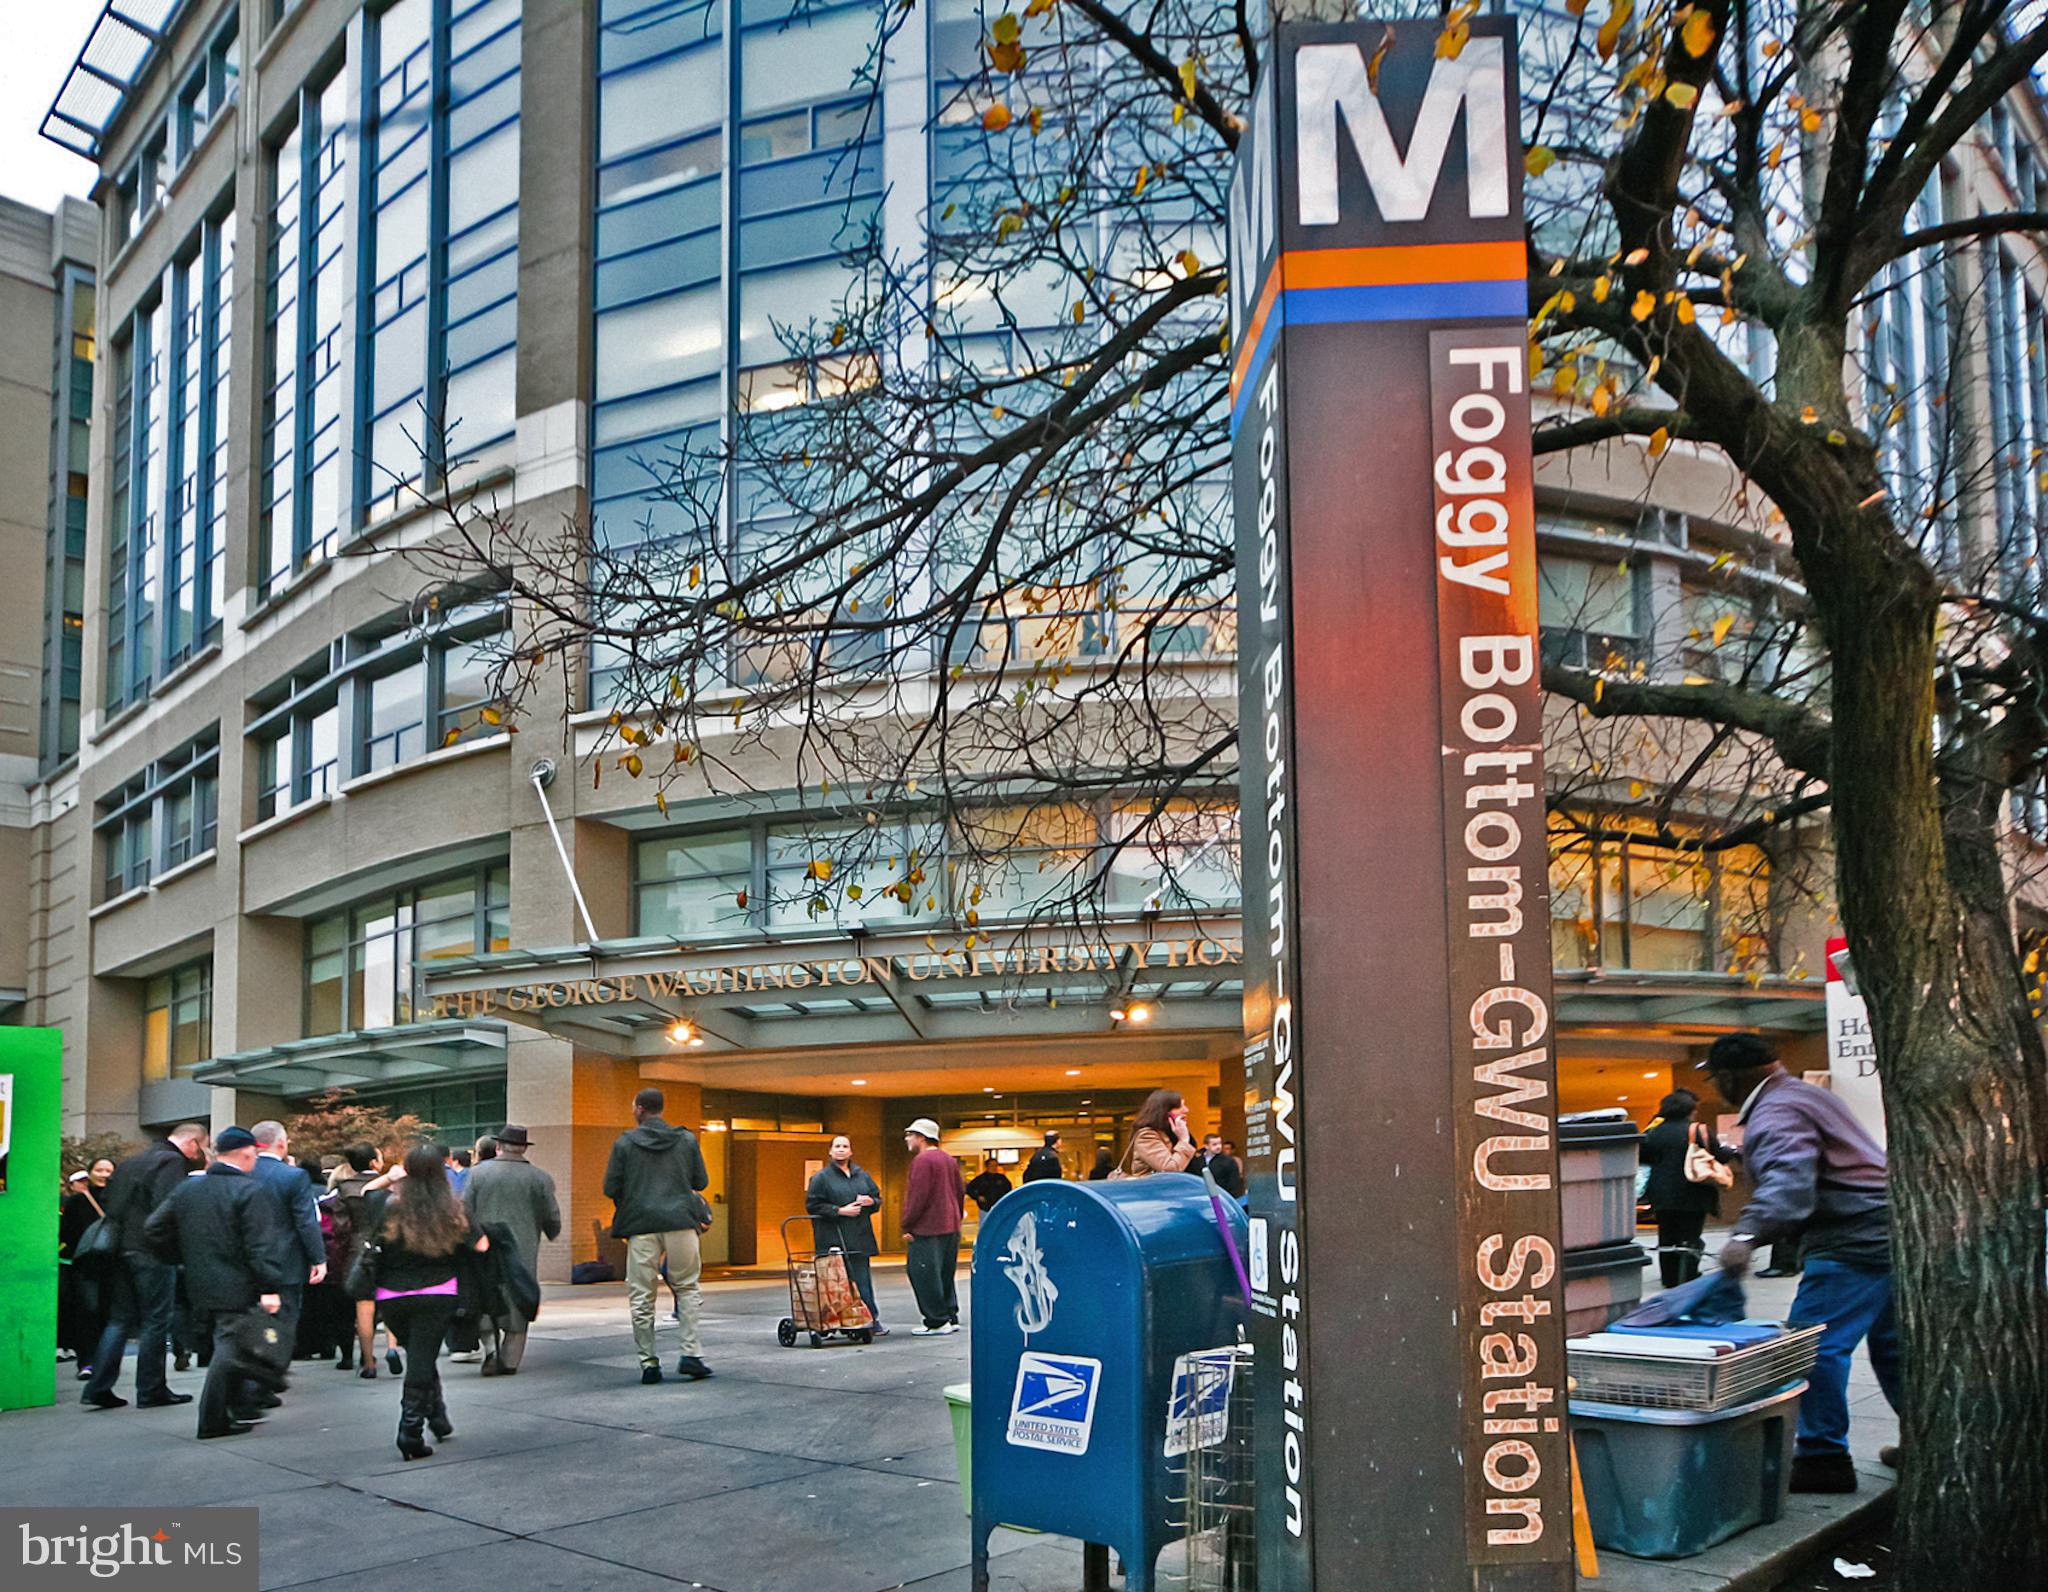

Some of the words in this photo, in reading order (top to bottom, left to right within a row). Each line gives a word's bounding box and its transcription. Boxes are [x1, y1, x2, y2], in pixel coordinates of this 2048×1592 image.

[1230, 64, 1274, 348] M
[1296, 36, 1510, 226] M
[1258, 361, 1279, 622] Foggy
[1434, 346, 1525, 596] Foggy
[434, 990, 497, 1017] THE
[506, 976, 638, 1011] GEORGE
[645, 957, 893, 999] WASHINGTON
[906, 942, 1153, 981] UNIVERSITY
[1264, 642, 1297, 1202] Bottom-GWU
[1459, 634, 1552, 1191] Bottom-GWU
[1856, 1059, 1879, 1077] D
[1012, 1430, 1044, 1442] POSTAL
[1047, 1436, 1081, 1448] SERVICE
[1014, 1420, 1048, 1431] UNITED
[1049, 1424, 1080, 1436] STATES
[1279, 1229, 1304, 1538] Station
[1476, 1233, 1560, 1545] Station
